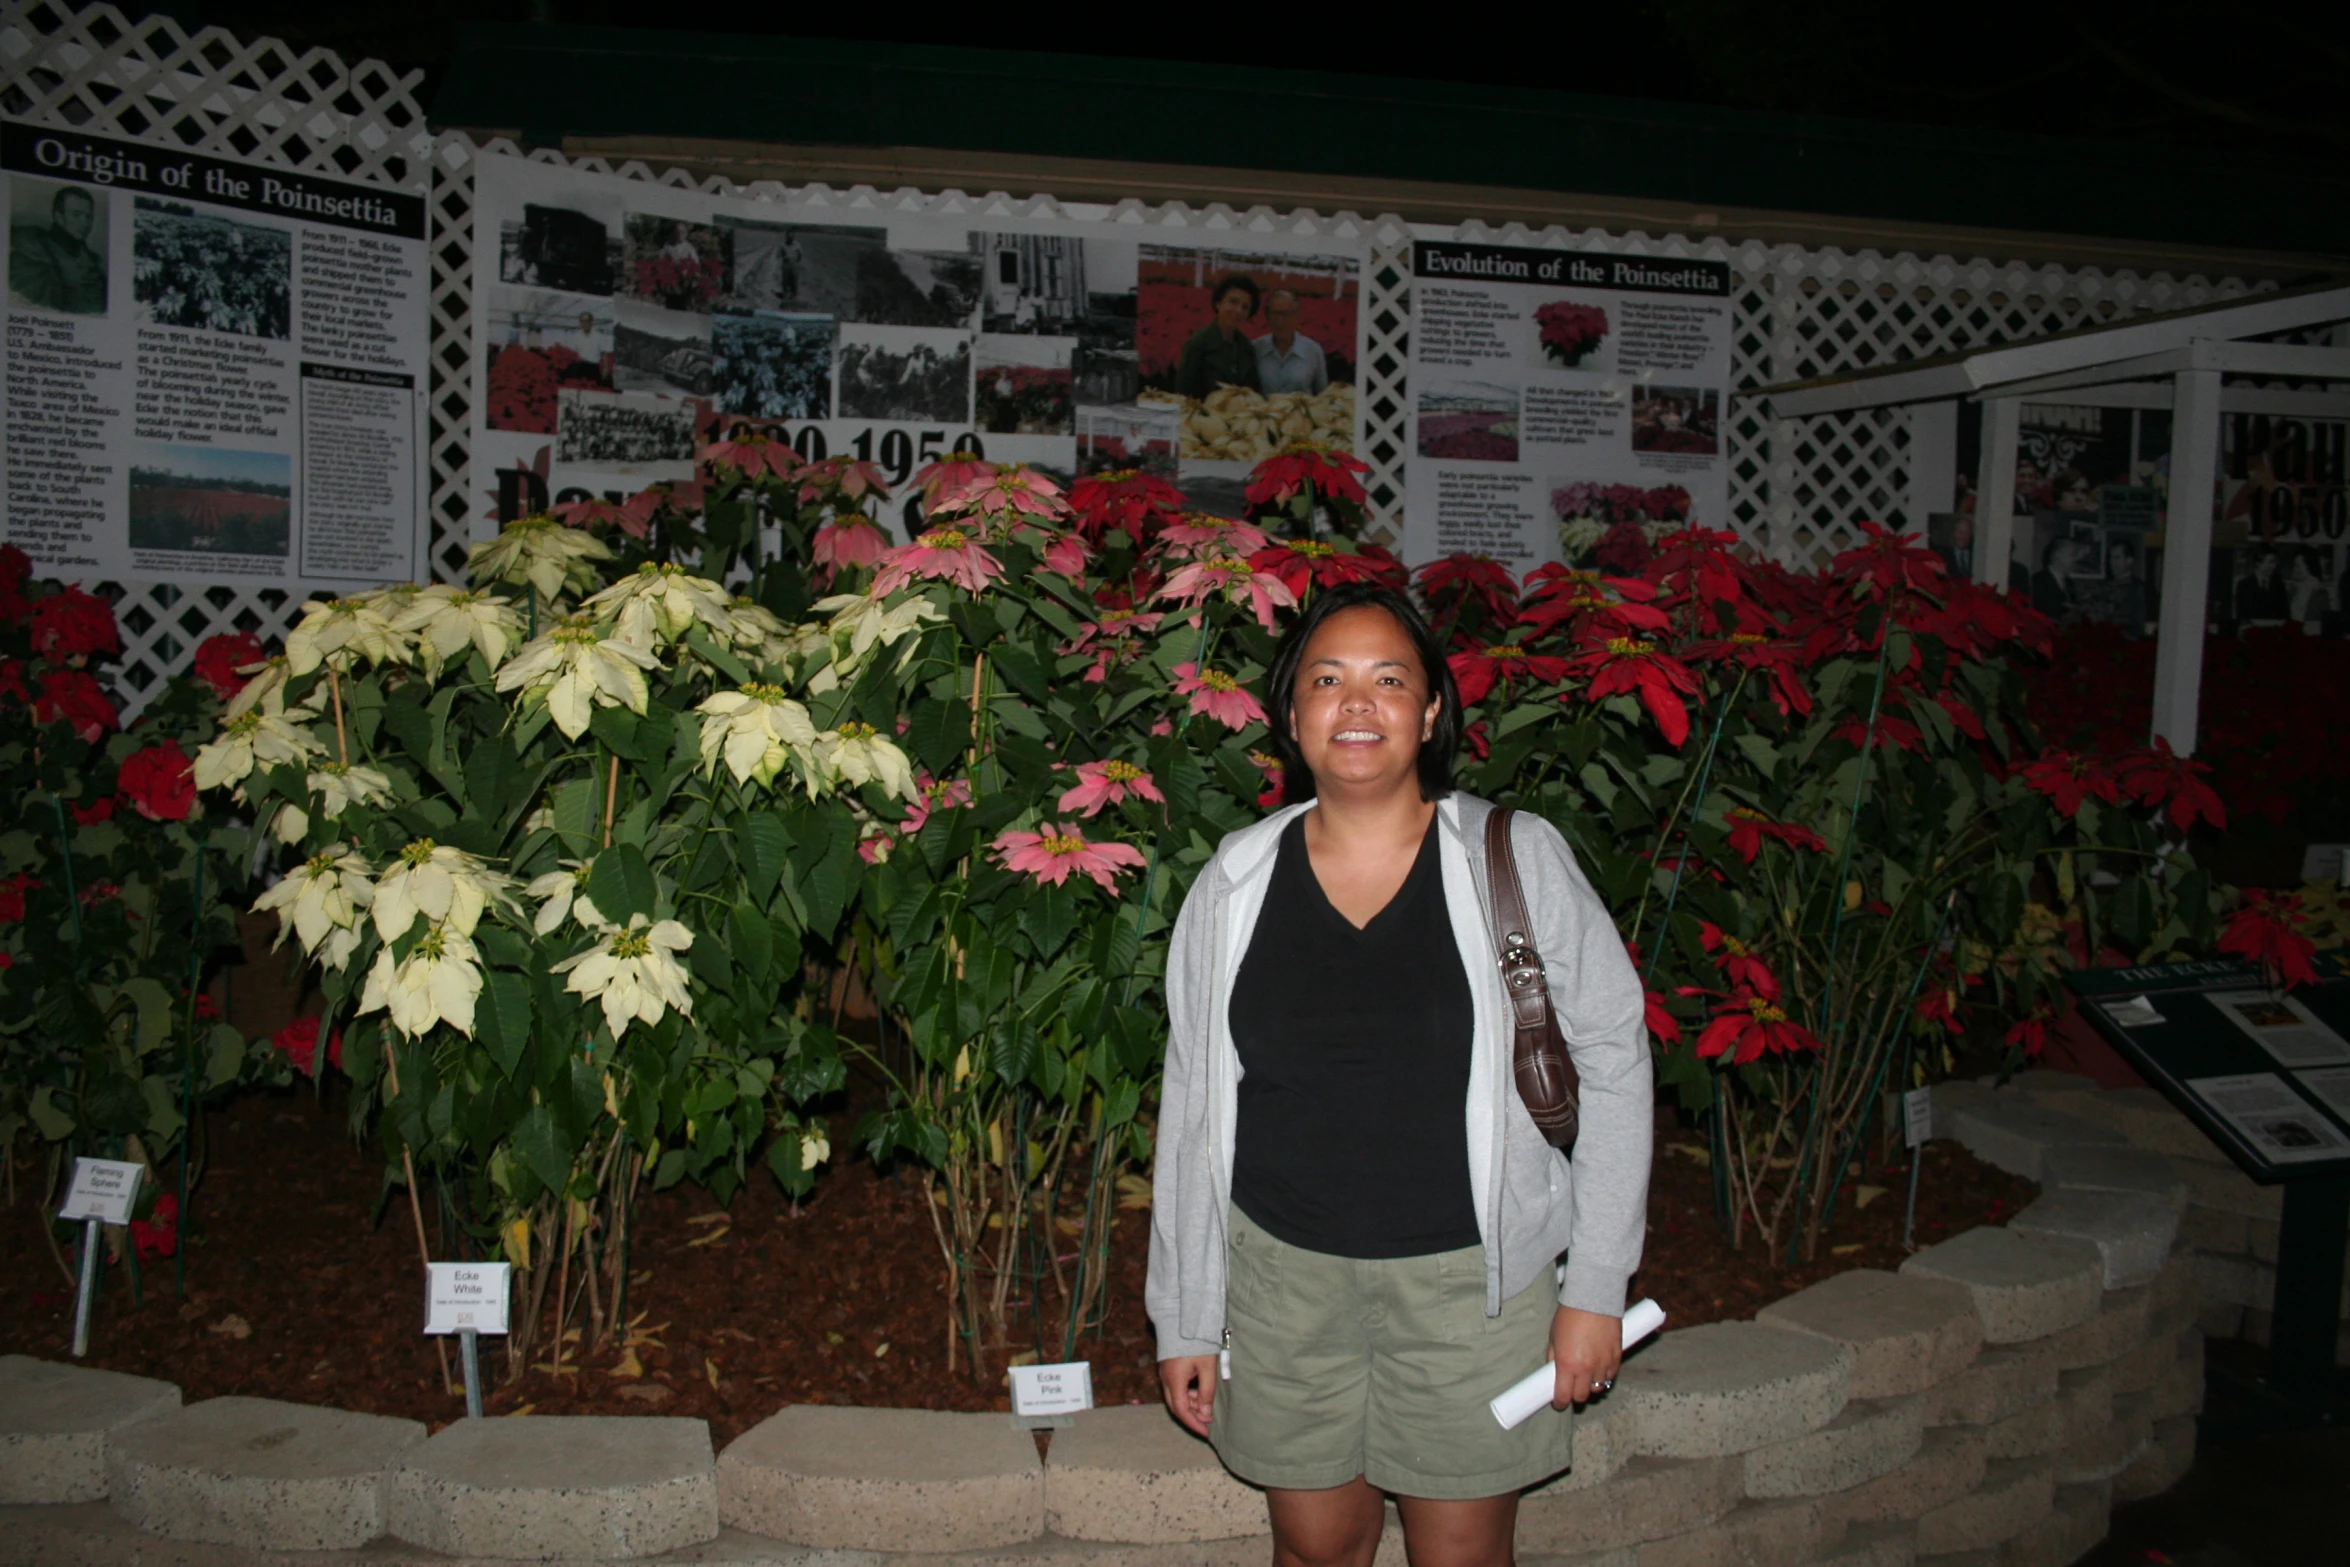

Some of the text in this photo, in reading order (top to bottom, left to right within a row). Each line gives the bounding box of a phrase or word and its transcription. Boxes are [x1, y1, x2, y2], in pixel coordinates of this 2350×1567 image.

[33, 138, 399, 227] Origin of the Poinsettia
[1424, 249, 1720, 291] Evolution of the Poinsettia
[337, 370, 346, 378] of
[348, 371, 362, 380] the
[364, 373, 404, 385] Poinsettia
[2248, 487, 2347, 539] 1950
[2113, 963, 2170, 982] THE
[91, 1165, 124, 1179] Flaming
[91, 1177, 121, 1188] Sphere
[454, 1270, 480, 1280] Ecke
[454, 1284, 482, 1294] White
[1037, 1372, 1061, 1382] Ecke
[1041, 1385, 1063, 1395] Pink
